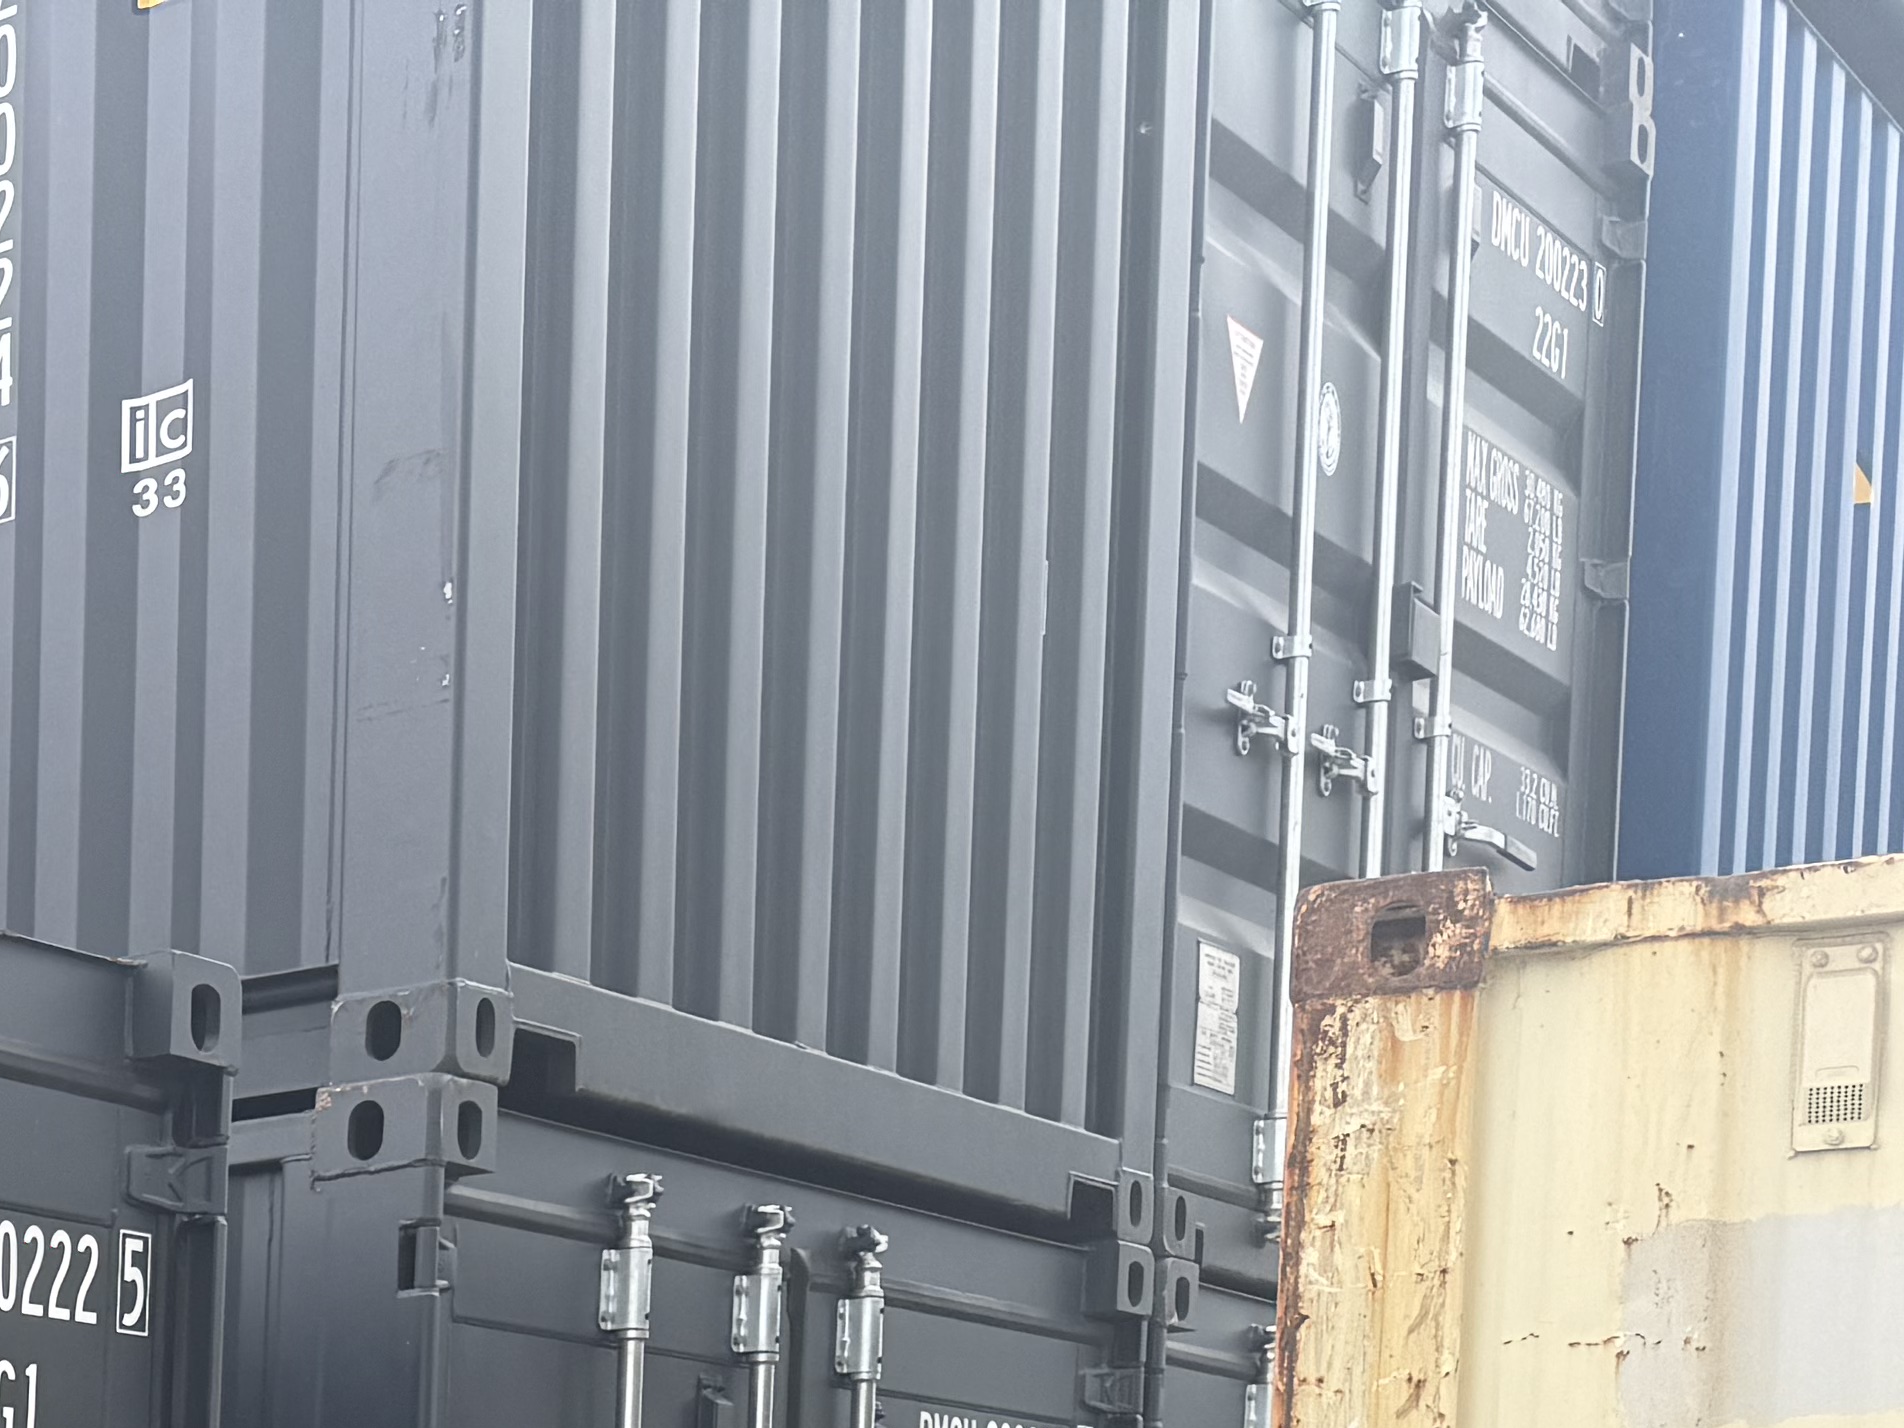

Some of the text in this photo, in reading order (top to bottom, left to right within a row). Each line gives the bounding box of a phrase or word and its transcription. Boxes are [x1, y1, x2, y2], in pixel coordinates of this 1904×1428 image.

[1492, 190, 1605, 322] DMCU 200223 0
[1533, 306, 1569, 380] 22G1
[132, 468, 187, 518] 33
[1465, 431, 1489, 496] MAX
[1465, 488, 1489, 554] TARE
[1462, 545, 1505, 619] PAYLOAD
[120, 1235, 148, 1330] 5
